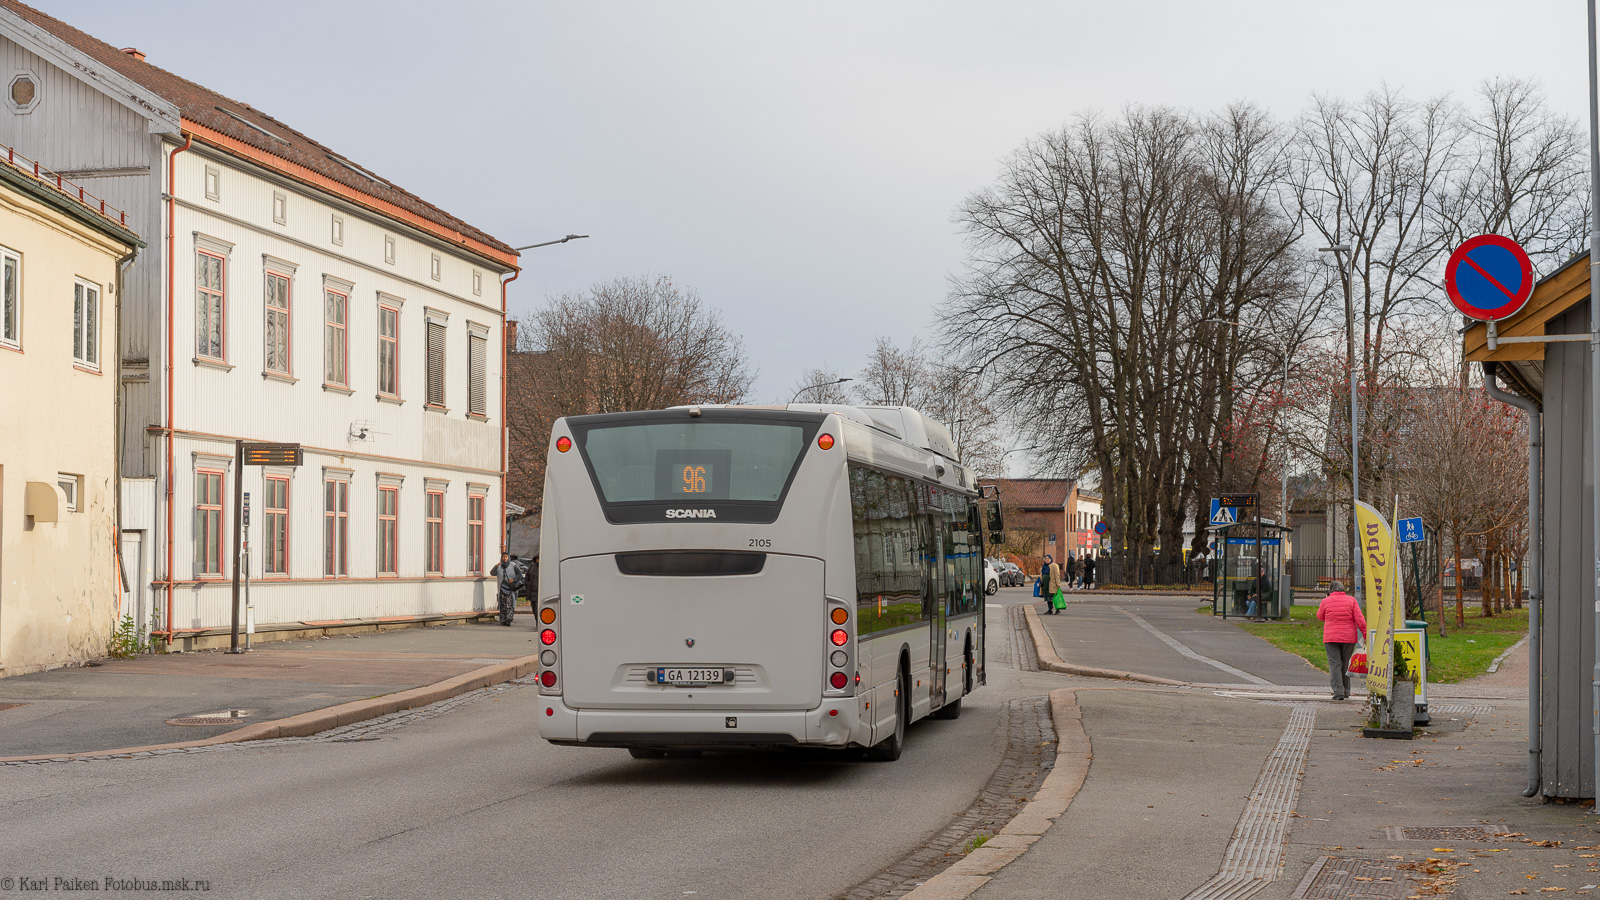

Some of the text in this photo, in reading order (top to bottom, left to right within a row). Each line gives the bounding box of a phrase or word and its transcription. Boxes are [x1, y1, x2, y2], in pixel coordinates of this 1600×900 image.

[683, 466, 706, 493] 96
[665, 509, 717, 519] SCANIA
[748, 538, 772, 548] 2105
[668, 670, 719, 681] GA 12139
